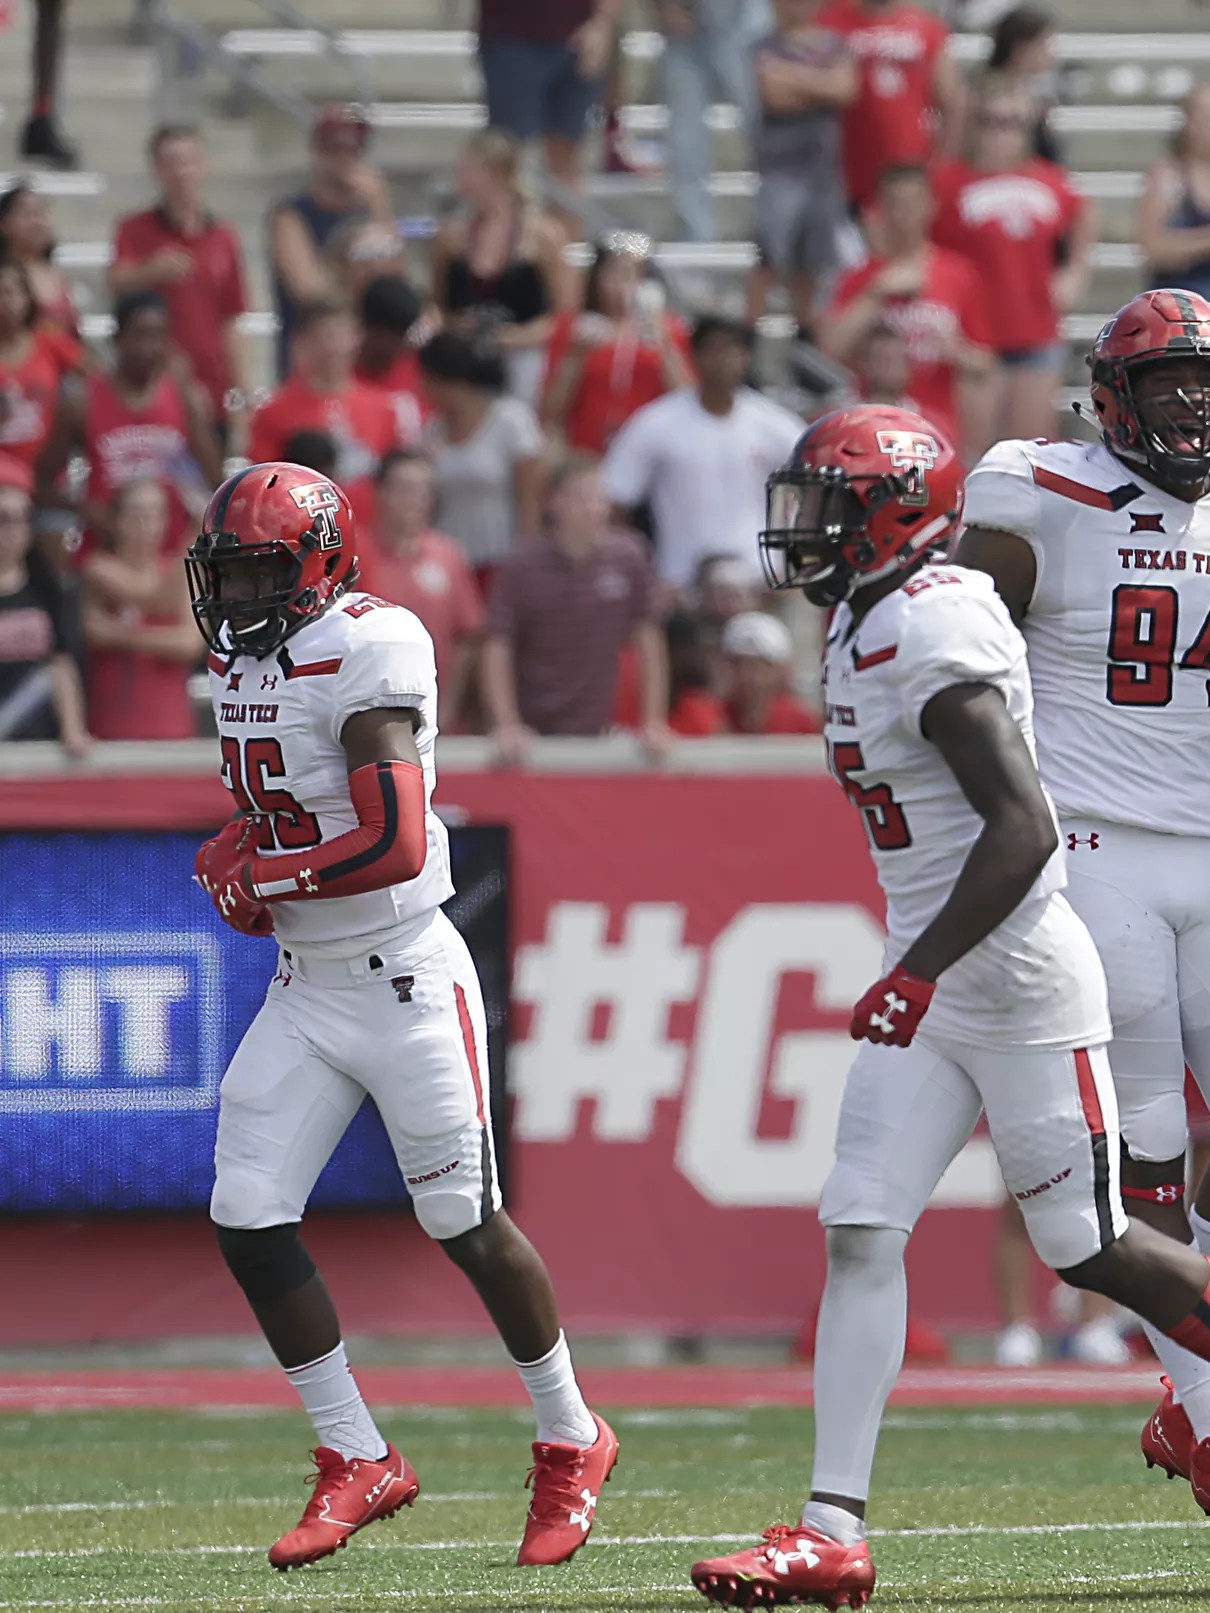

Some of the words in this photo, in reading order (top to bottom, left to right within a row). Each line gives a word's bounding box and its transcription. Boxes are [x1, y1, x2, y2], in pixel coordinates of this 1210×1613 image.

[1118, 549, 1187, 570] TEXAS
[220, 703, 247, 722] TEXAS
[249, 704, 279, 723] TECH
[826, 741, 914, 850] 5
